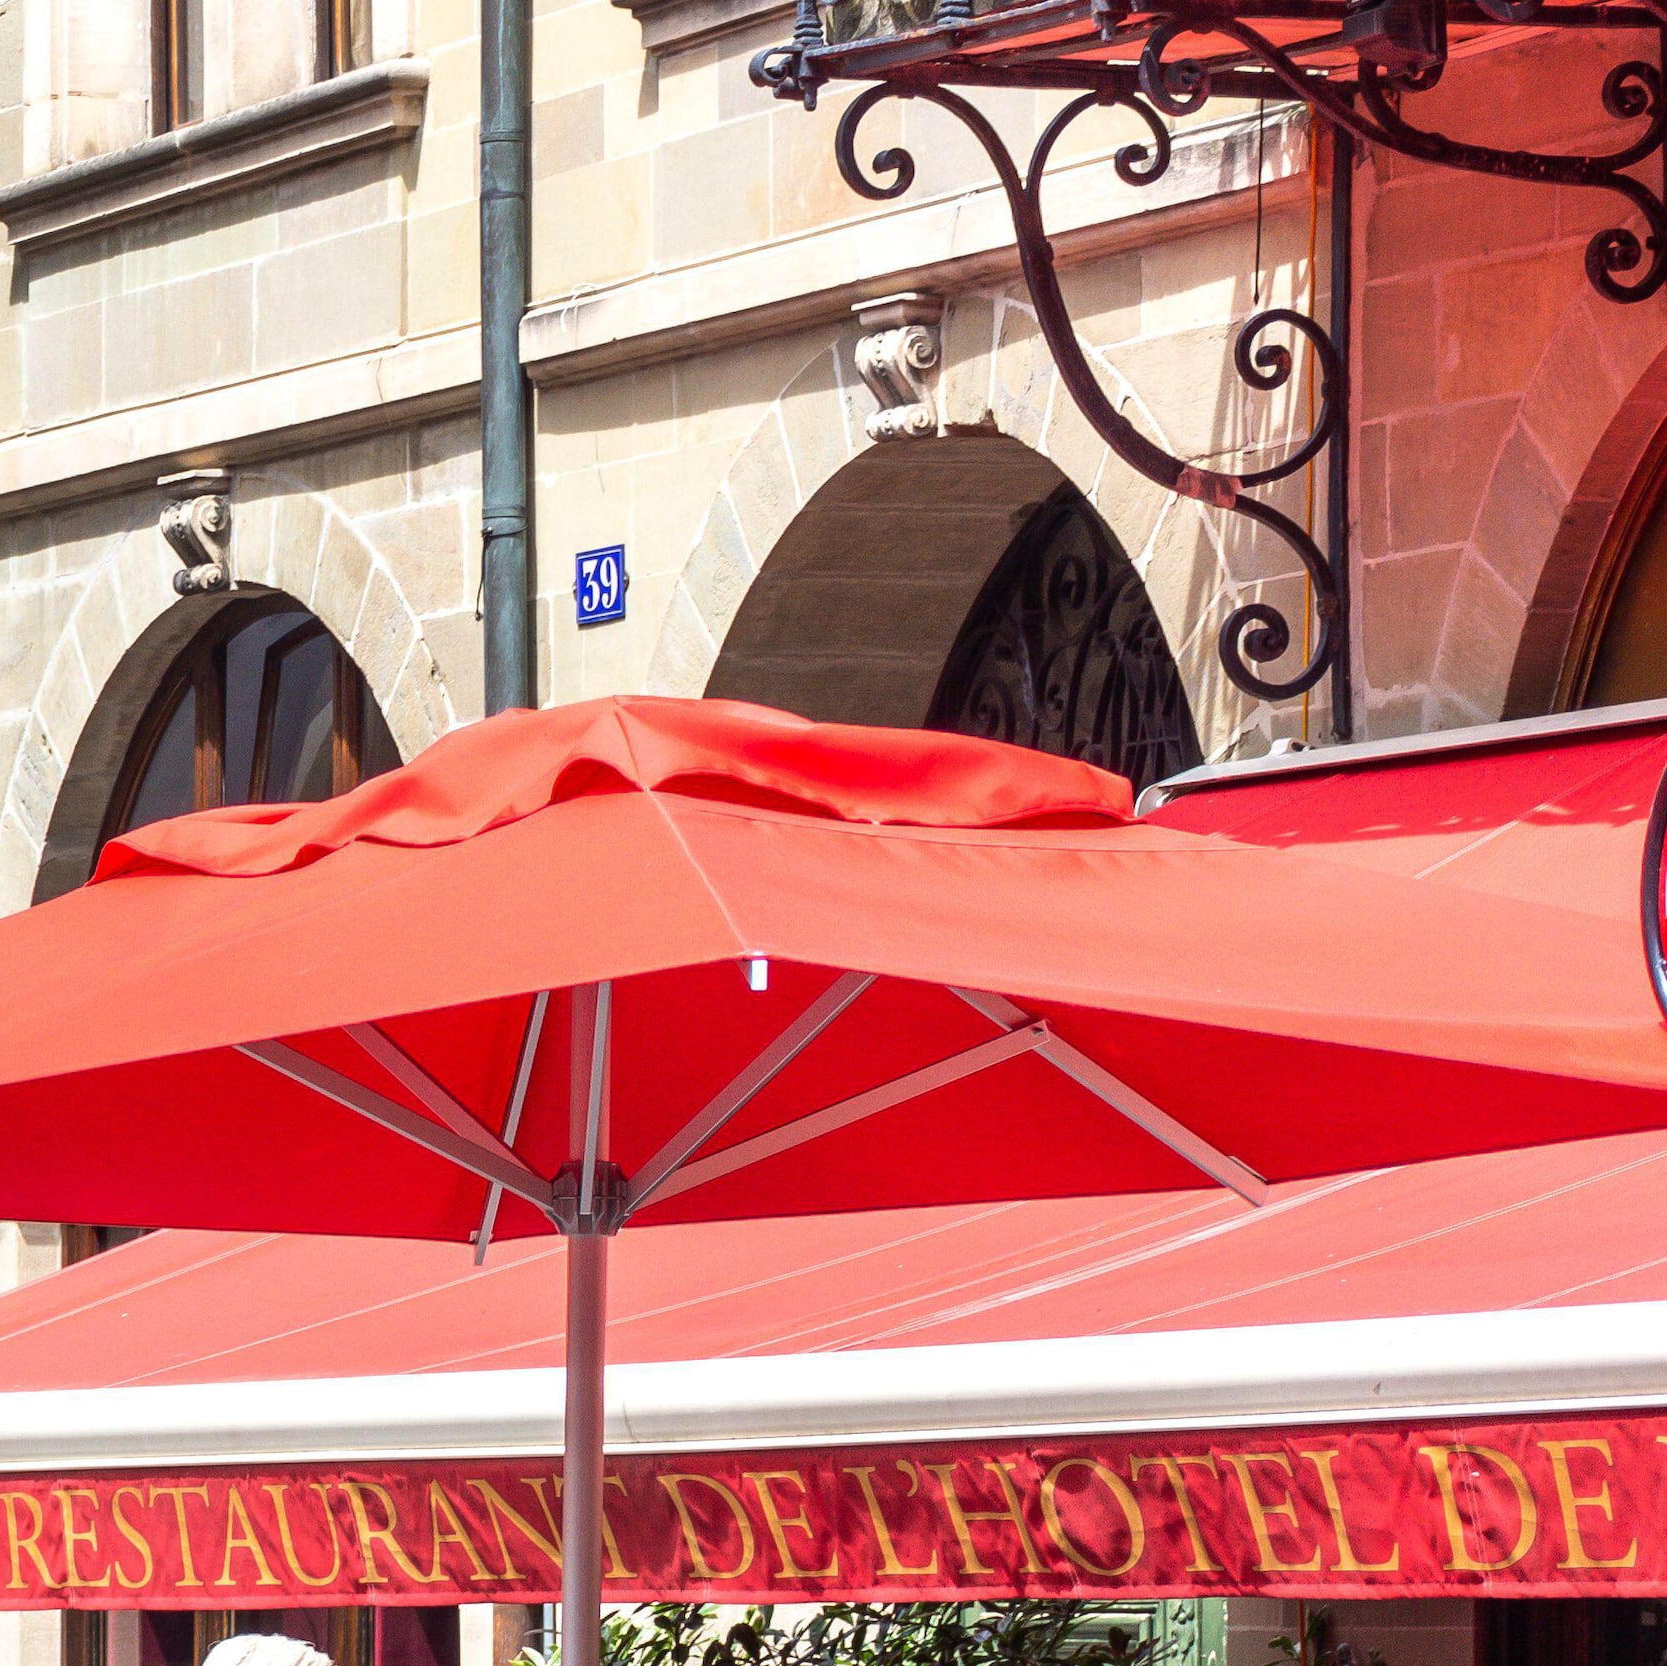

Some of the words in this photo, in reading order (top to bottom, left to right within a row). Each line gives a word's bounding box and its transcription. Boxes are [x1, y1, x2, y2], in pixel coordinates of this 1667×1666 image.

[582, 556, 619, 612] 39
[3, 1472, 638, 1590] RESTAURANT
[657, 1473, 840, 1579] DE
[846, 1449, 1399, 1577] L'HOTEL
[1417, 1438, 1639, 1571] DE
